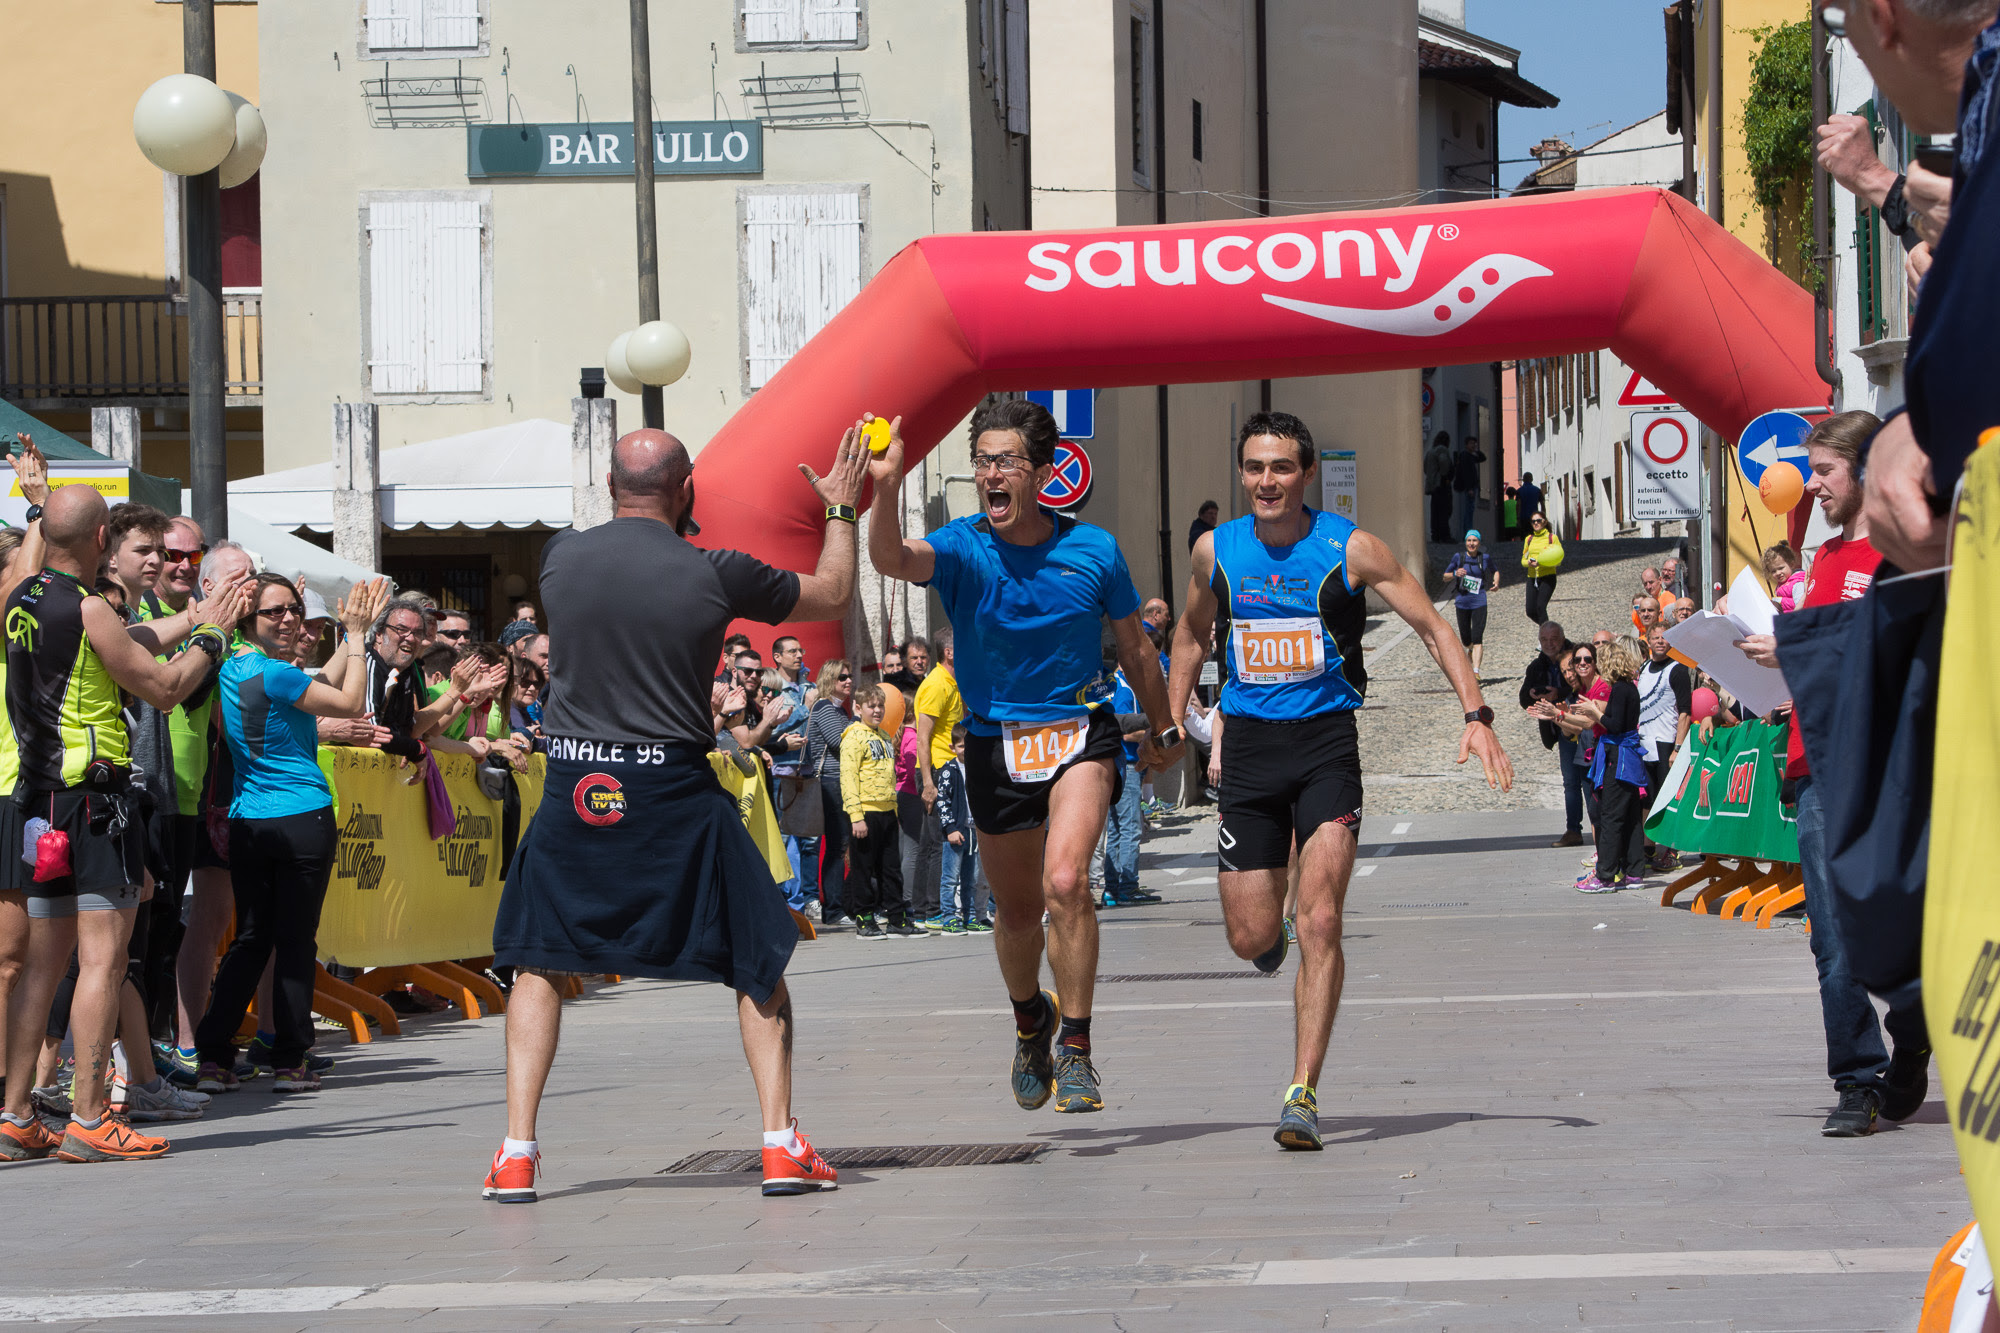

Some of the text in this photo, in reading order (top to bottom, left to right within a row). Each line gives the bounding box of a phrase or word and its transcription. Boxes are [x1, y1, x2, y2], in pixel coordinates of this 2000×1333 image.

[549, 131, 749, 164] BAR ULLO
[1646, 470, 1688, 479] eccetto
[1241, 575, 1309, 595] CMP
[1236, 595, 1312, 606] TRAIL TEAM
[1247, 637, 1308, 667] 2001
[547, 736, 665, 765] CANALE 95
[1019, 729, 1074, 764] 2147
